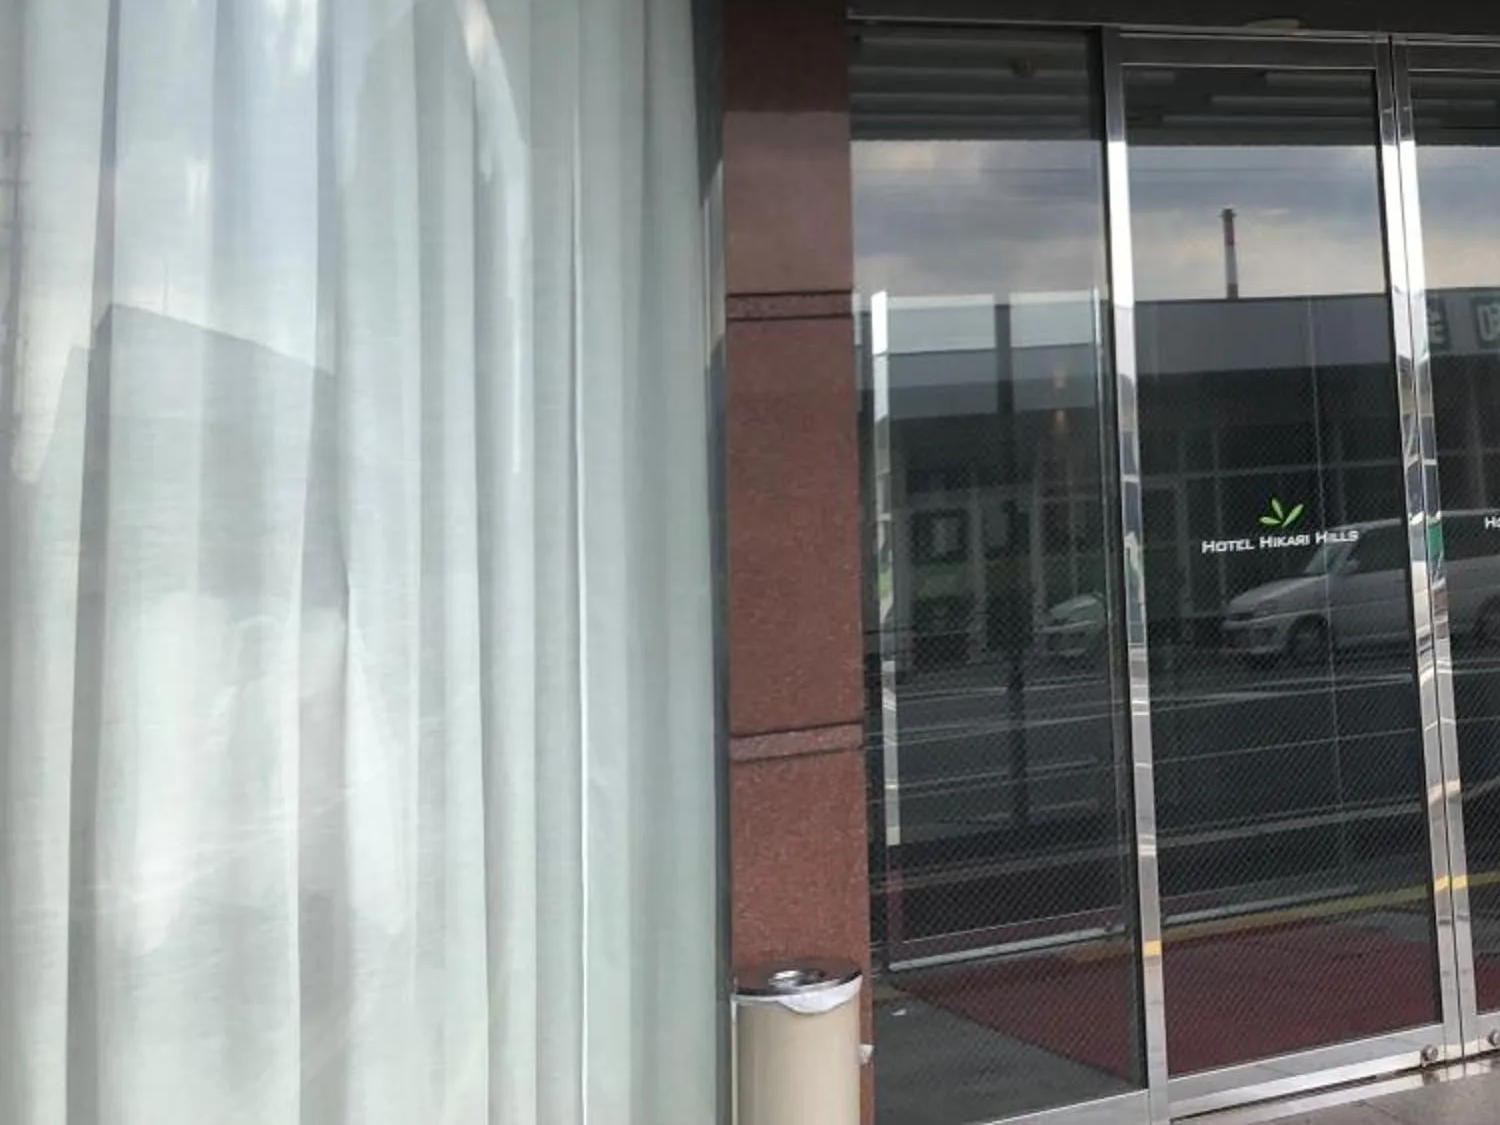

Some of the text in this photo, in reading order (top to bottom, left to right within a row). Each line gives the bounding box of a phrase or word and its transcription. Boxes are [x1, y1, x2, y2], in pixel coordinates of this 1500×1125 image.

[1201, 530, 1360, 554] HOTEL HIKARI HILLS
